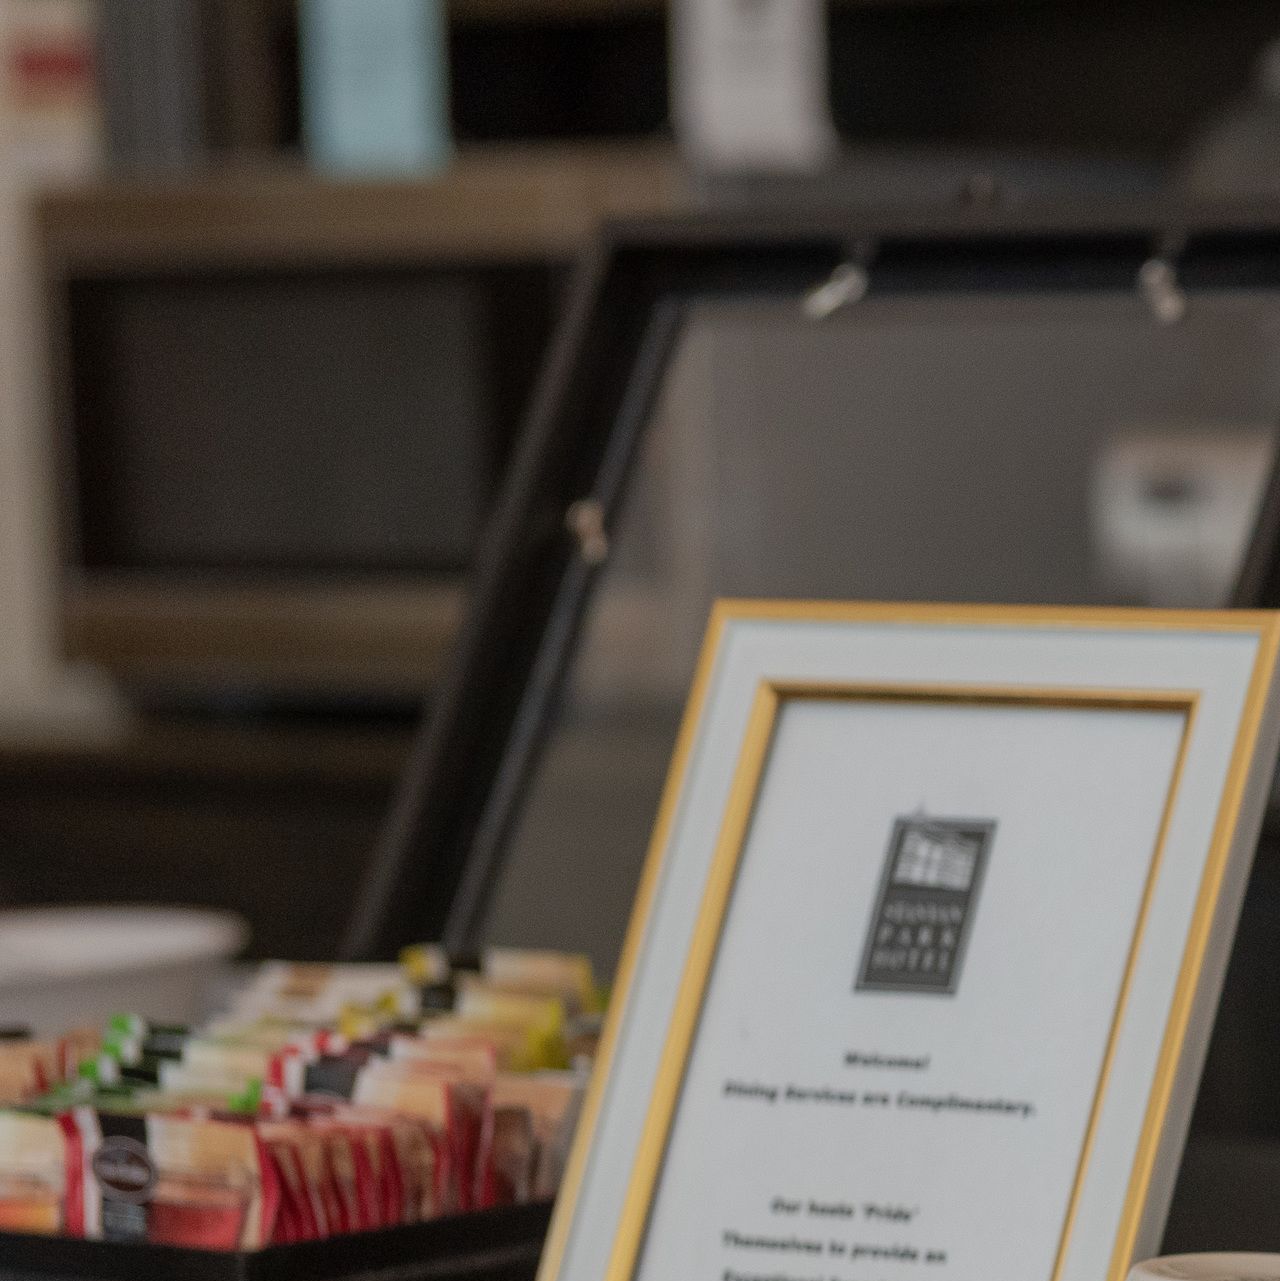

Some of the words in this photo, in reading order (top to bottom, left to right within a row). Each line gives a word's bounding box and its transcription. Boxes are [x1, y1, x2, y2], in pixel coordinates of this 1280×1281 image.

[784, 1081, 856, 1103] Services
[861, 1091, 889, 1104] are
[722, 1230, 822, 1251] Themselves
[852, 1244, 918, 1260] provide
